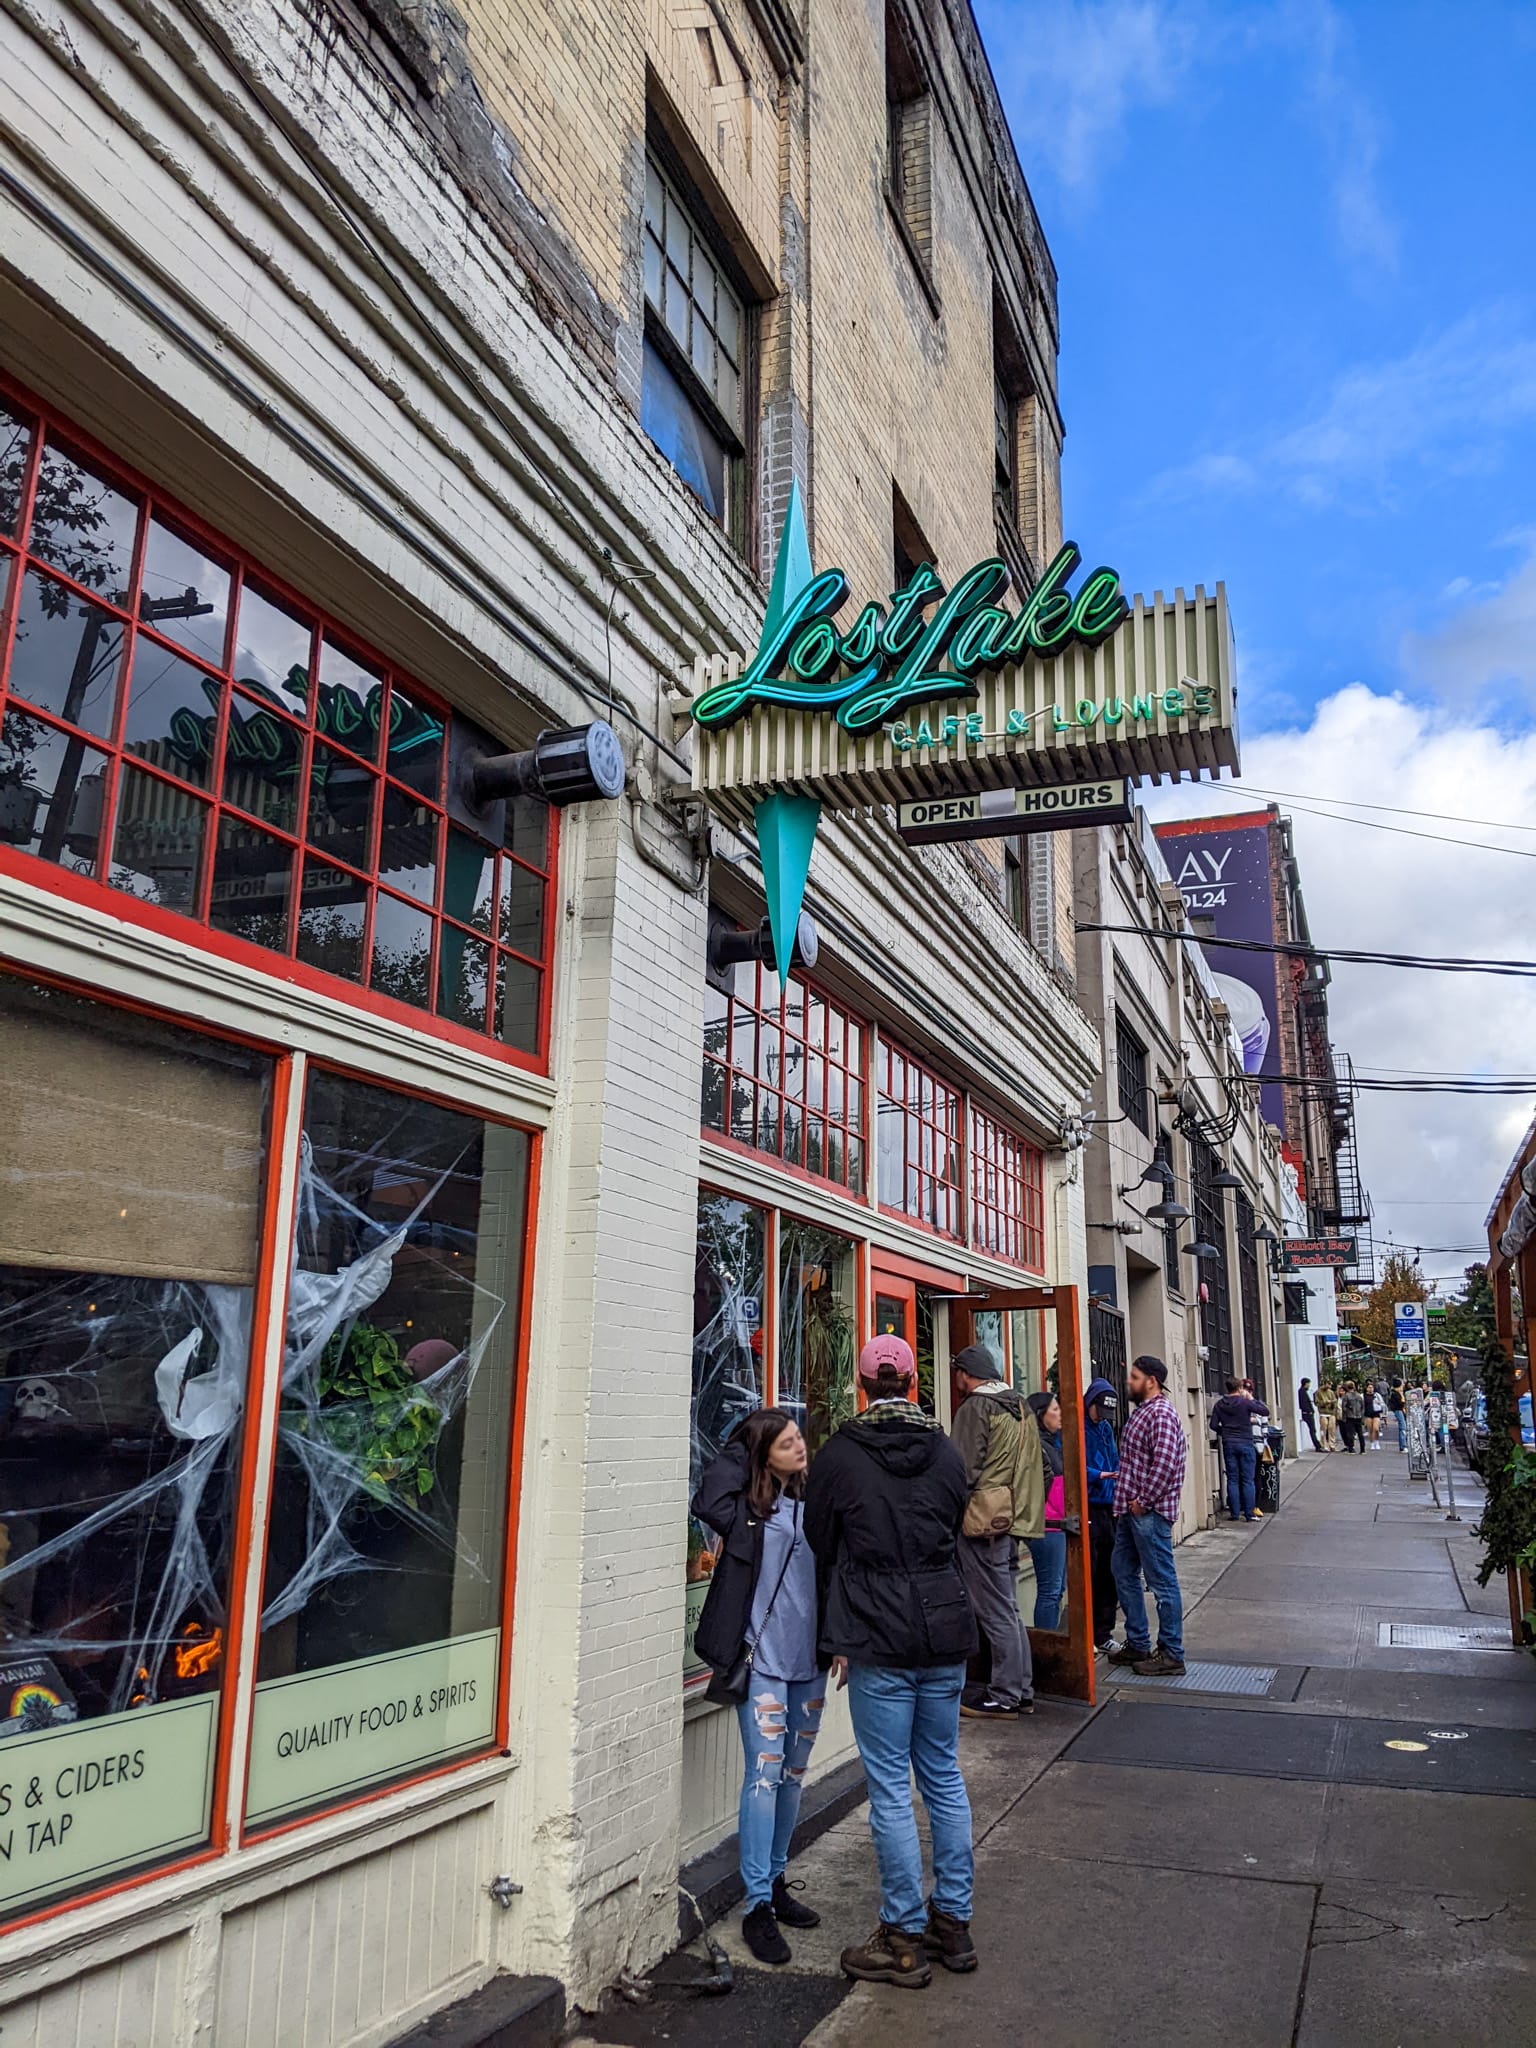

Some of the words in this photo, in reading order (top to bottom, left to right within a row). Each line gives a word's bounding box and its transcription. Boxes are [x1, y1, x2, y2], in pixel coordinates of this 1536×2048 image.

[691, 560, 946, 733] Lost
[836, 540, 1129, 738] Lake
[891, 711, 984, 751] CAFE
[1006, 708, 1029, 737] &
[1052, 685, 1214, 733] LOUNGE
[911, 801, 974, 823] OPEN
[1025, 785, 1113, 812] HOURS
[1174, 847, 1233, 886] AY
[1291, 1254, 1325, 1265] Book
[1328, 1240, 1352, 1252] Bay
[686, 1605, 701, 1625] ERS
[277, 1713, 353, 1758] QUALITY
[359, 1700, 407, 1735] FOOD
[413, 1694, 423, 1719] &
[429, 1679, 477, 1713] SPIRITS
[25, 1776, 43, 1809] &
[56, 1749, 144, 1799] CIDERS
[27, 1813, 73, 1855] TAP
